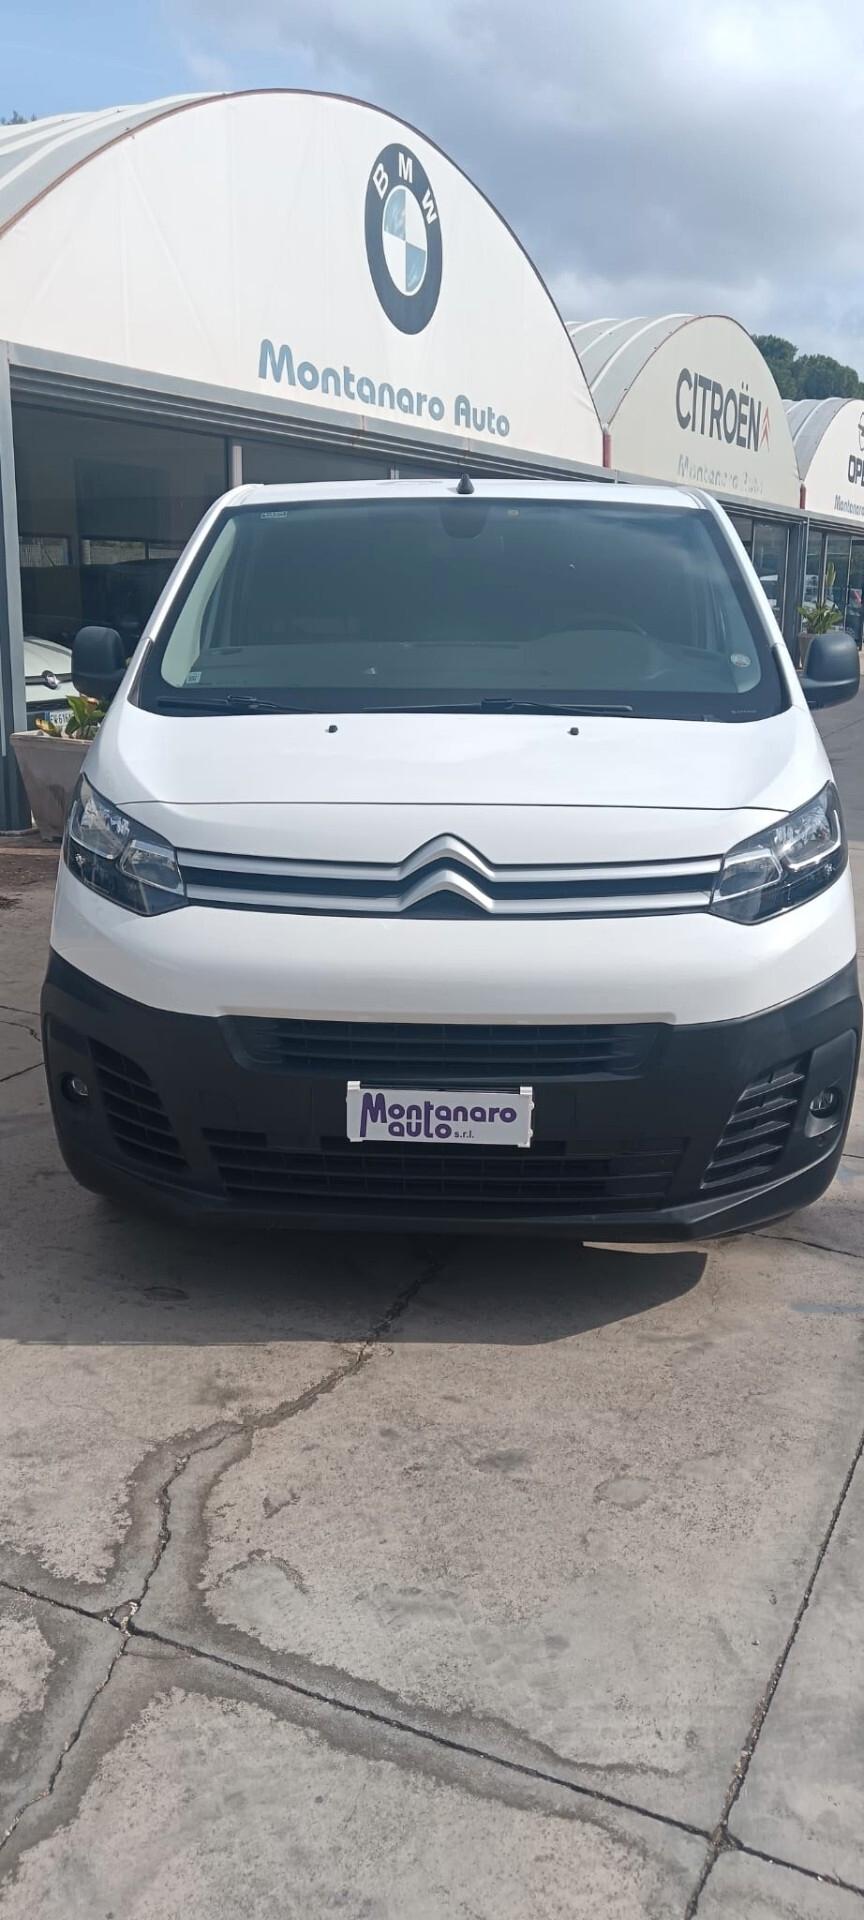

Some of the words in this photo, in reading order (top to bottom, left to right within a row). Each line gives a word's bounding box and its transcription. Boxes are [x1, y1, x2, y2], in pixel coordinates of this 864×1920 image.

[373, 152, 438, 225] BMW
[258, 338, 445, 422] Montanaro
[454, 394, 510, 438] Auto
[675, 367, 762, 452] CITROËN
[678, 453, 738, 490] Montano
[360, 1092, 517, 1138] Montanaro
[388, 1120, 452, 1139] auto
[454, 1130, 475, 1139] s.r.l.
